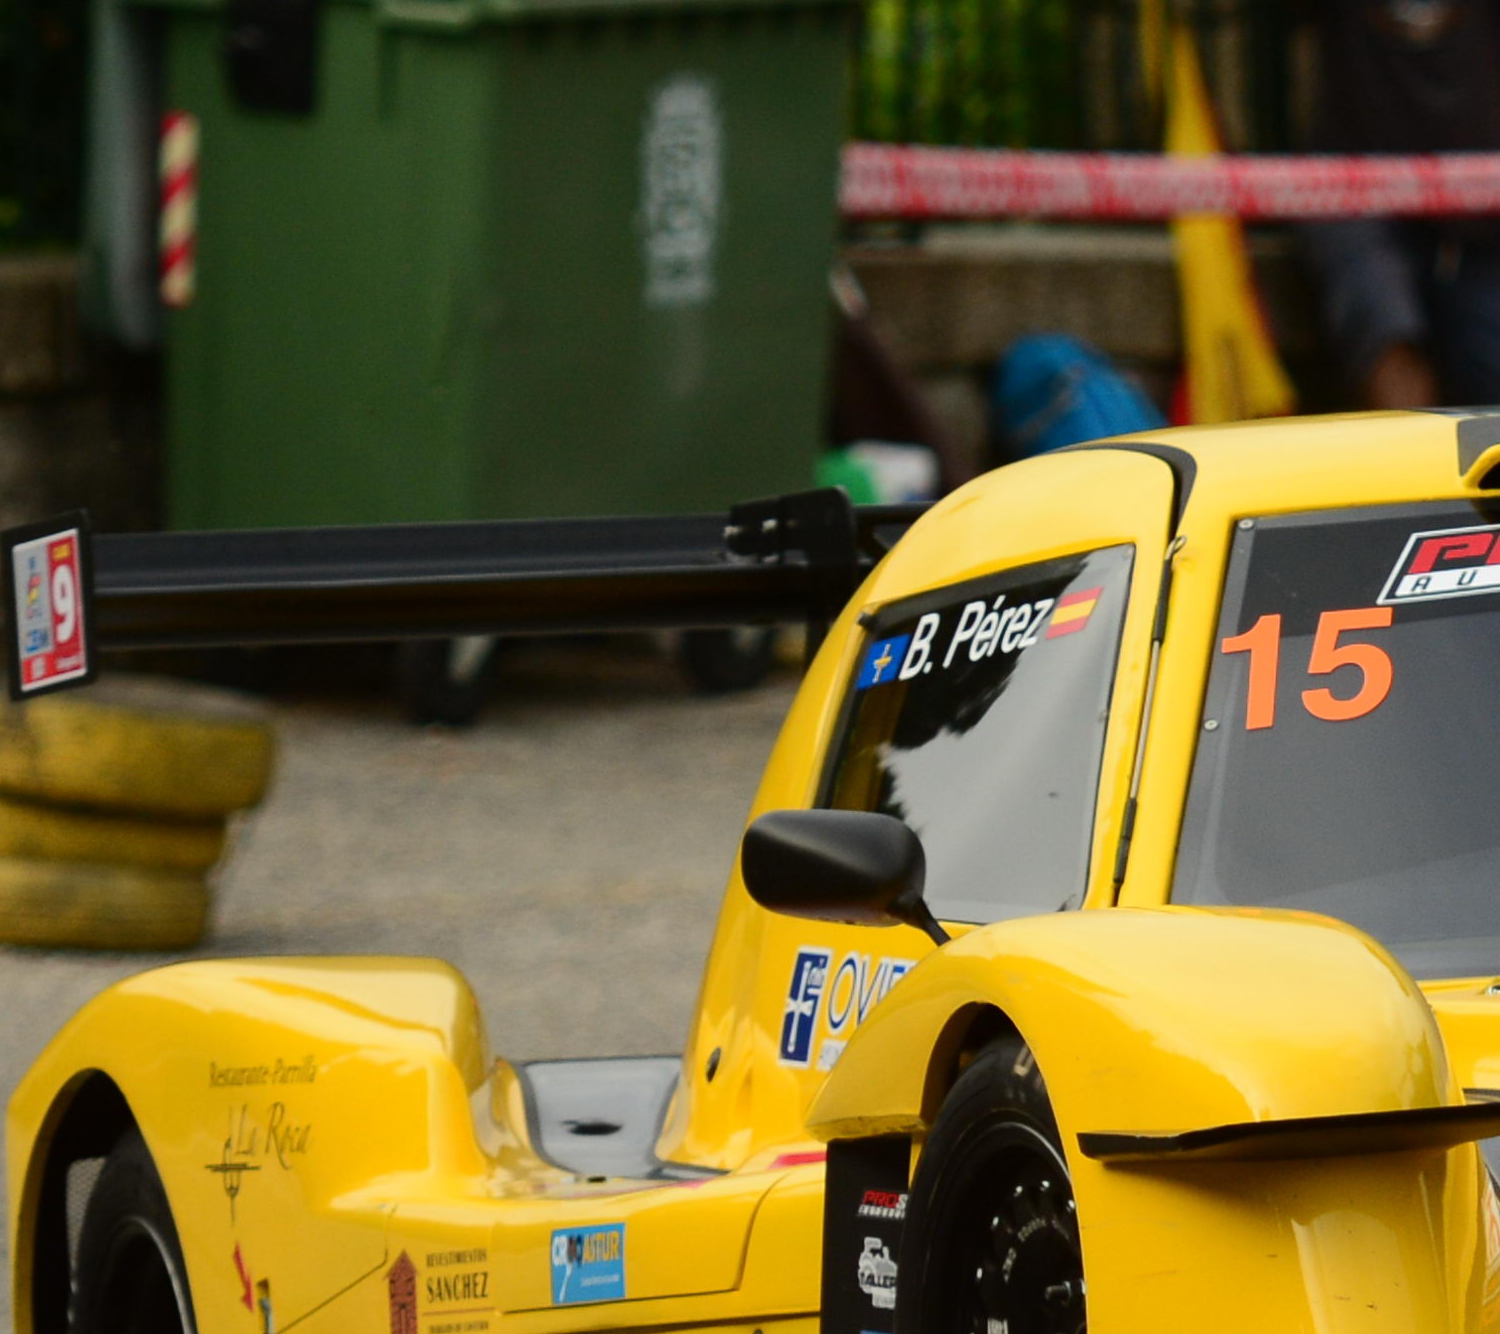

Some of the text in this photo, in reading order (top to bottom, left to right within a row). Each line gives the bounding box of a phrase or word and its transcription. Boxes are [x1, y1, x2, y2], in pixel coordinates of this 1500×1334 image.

[51, 563, 76, 644] 9
[898, 594, 1056, 681] B. Pérez
[1221, 606, 1394, 730] 15
[425, 1271, 489, 1304] SANCHEZ
